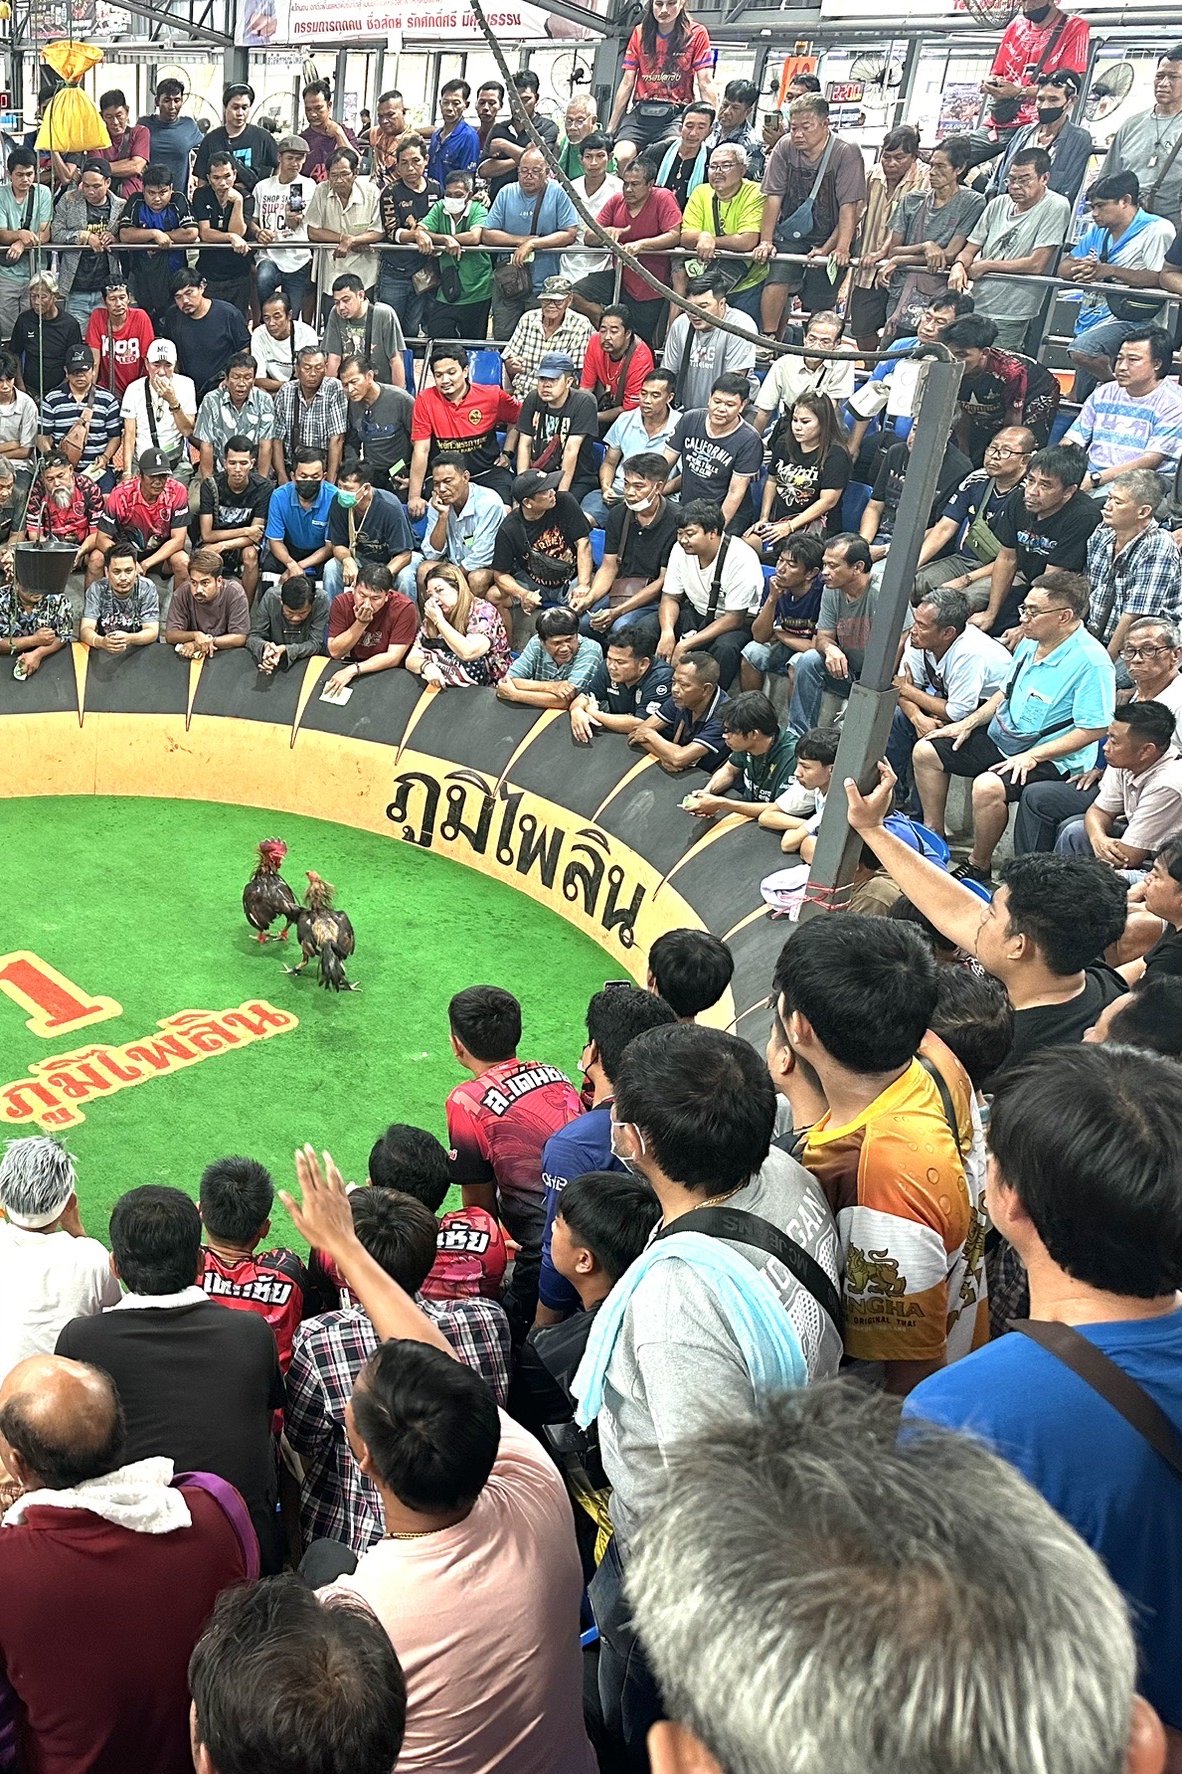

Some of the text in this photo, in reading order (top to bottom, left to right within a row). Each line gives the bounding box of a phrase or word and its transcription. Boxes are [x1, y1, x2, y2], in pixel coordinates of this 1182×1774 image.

[120, 355, 136, 364] LEO
[685, 437, 733, 467] CALIFORNIA
[386, 769, 647, 949] ภูมิไพลิน
[0, 1001, 294, 1127] ภูมิไพลิน
[844, 1296, 926, 1318] INGHA
[853, 1316, 891, 1325] ORIGINAL
